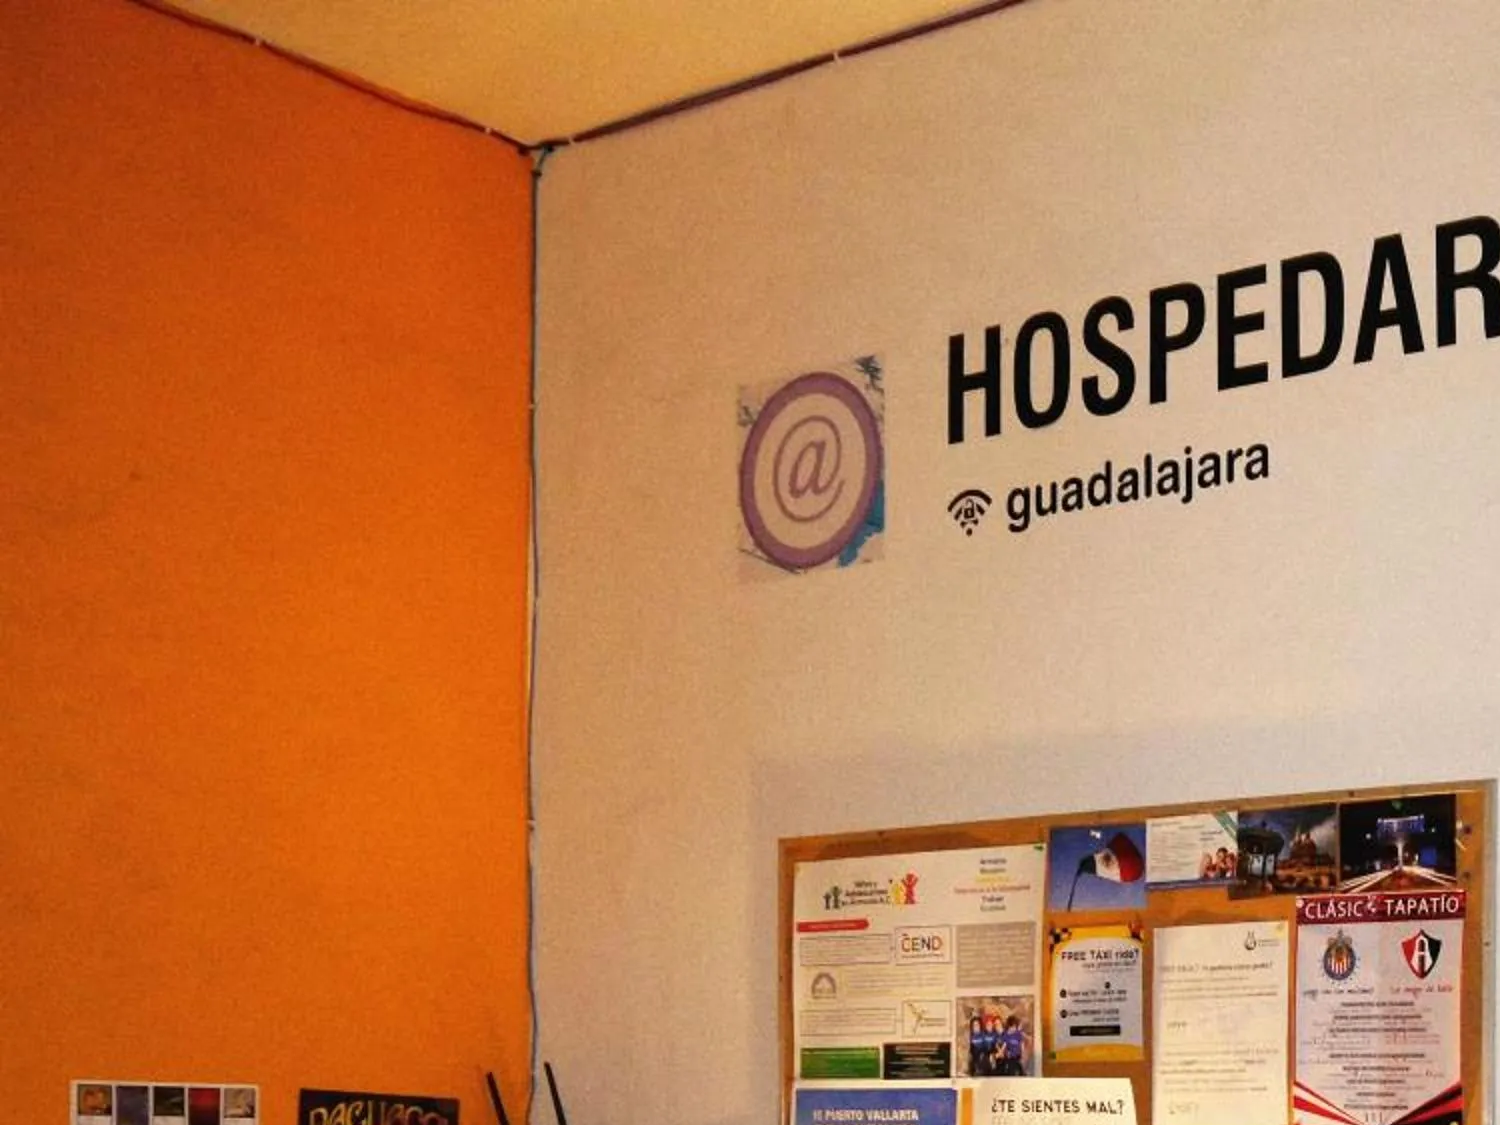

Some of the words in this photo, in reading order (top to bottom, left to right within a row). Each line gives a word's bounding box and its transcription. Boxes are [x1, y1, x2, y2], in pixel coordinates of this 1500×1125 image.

[1005, 443, 1270, 533] guadalajara
[866, 1109, 919, 1120] VALLARTA
[992, 1098, 1015, 1113] ¿TE
[1021, 1099, 1080, 1113] SIENTES
[1086, 1098, 1124, 1115] MAL?
